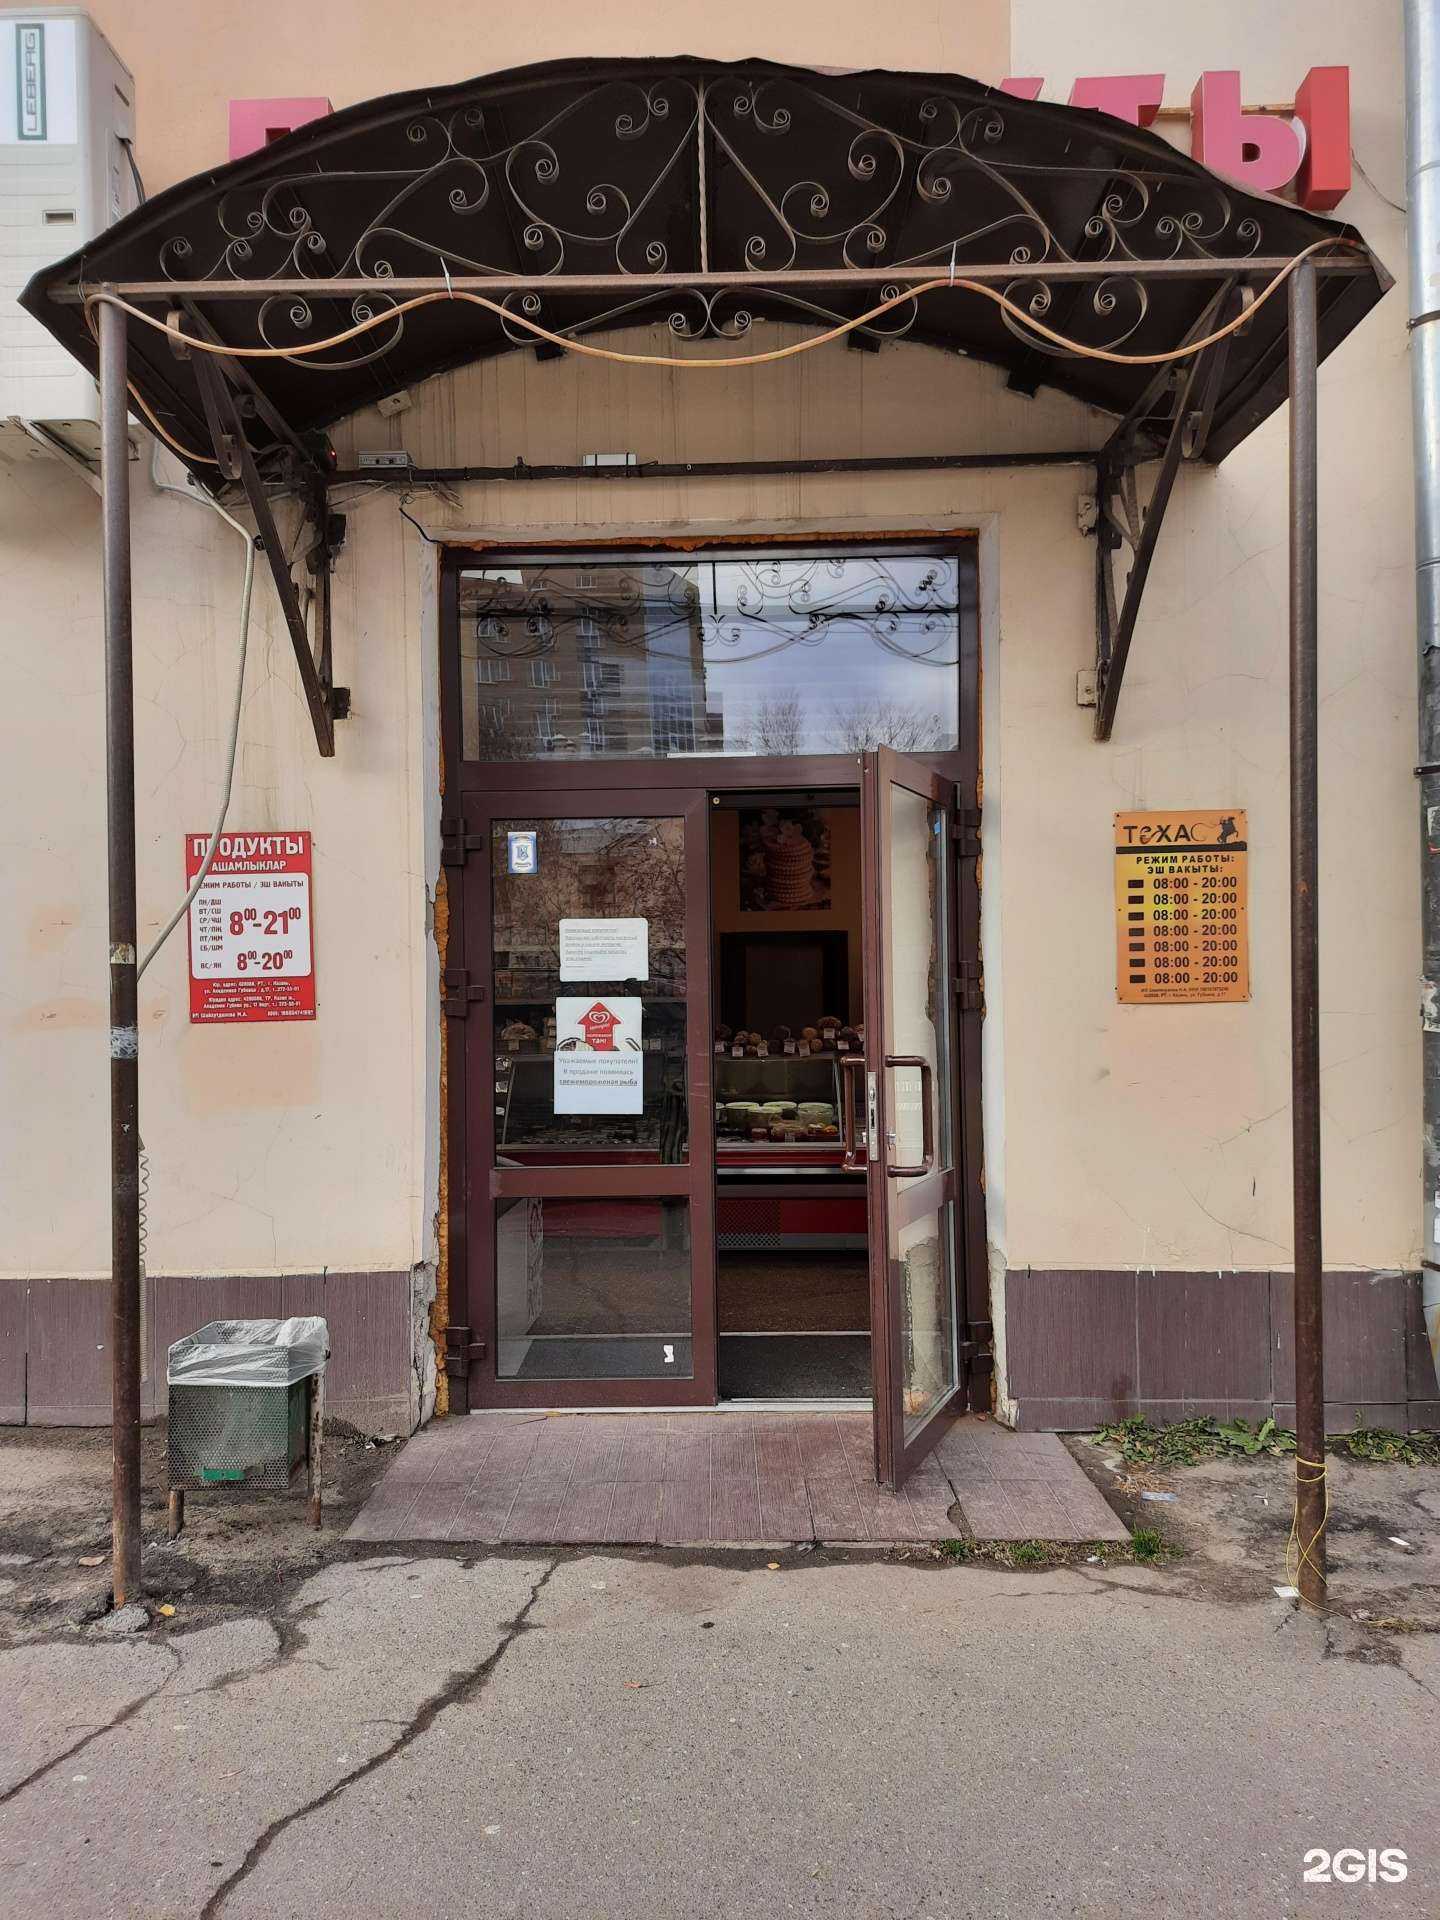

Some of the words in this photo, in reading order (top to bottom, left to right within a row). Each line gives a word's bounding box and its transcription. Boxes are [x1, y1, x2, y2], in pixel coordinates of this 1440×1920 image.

[25, 32, 38, 132] LEBERG
[193, 836, 304, 859] ПОДУКТЫ
[1136, 855, 1178, 865] РЕЖИМ
[1182, 854, 1235, 864] РАБОТЫ:
[212, 860, 287, 872] АШАМЛЫКЛАР
[1147, 866, 1165, 875] ЭШ
[1169, 865, 1223, 874] ВАКЫТЫ:
[222, 881, 252, 889] РАБОТЫ
[260, 880, 271, 888] ЭШ
[1153, 878, 1189, 889] 08:00
[1201, 876, 1237, 887] 20:00
[1153, 894, 1189, 905] 08:00
[1201, 892, 1237, 903] 20:00
[1153, 909, 1189, 920] 08:00
[1201, 908, 1237, 919] 20:00
[1153, 925, 1189, 936] 08:00
[1201, 924, 1237, 935] 20:00
[1153, 941, 1189, 952] 08:00
[1201, 940, 1237, 951] 20:00
[1154, 957, 1190, 968] 08:00
[1202, 956, 1238, 966] 20:00
[1154, 972, 1190, 983] 08:00
[1202, 971, 1238, 983] 20:00
